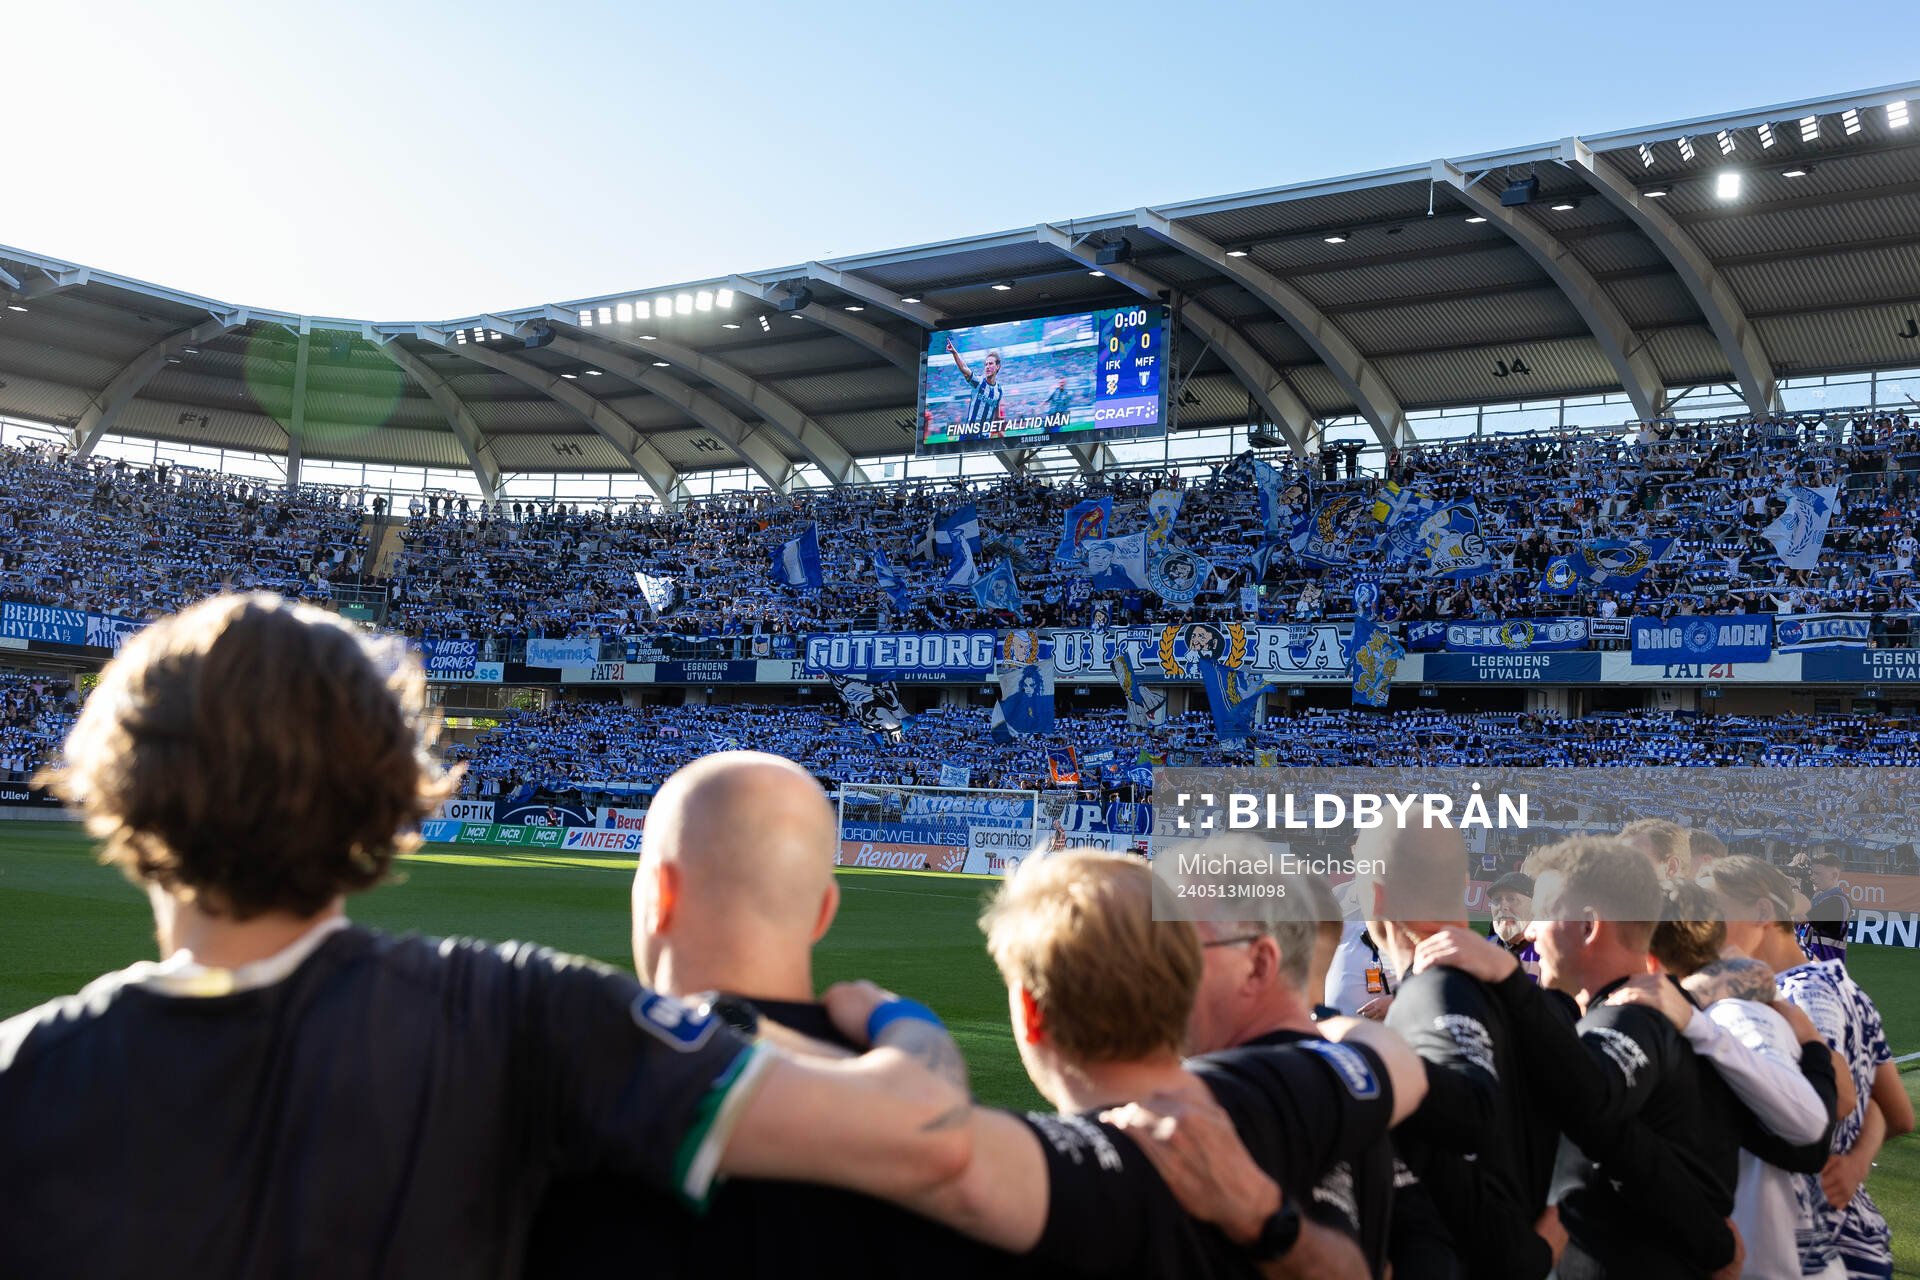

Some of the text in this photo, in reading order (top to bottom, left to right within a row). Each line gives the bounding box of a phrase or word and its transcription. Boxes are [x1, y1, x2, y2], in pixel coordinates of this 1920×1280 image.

[1115, 310, 1146, 328] 0:00
[1109, 337, 1119, 353] 0
[1141, 333, 1150, 349] 0
[1105, 360, 1121, 370] IFK
[1135, 356, 1155, 367] MFF
[1095, 405, 1145, 420] CRAFT
[946, 413, 1070, 436] FINNS DET ALLTID NÅN
[1020, 434, 1050, 443] SAMSUNG
[4, 604, 85, 627] BEBBENS
[2, 620, 60, 640] HYLLA
[1449, 626, 1501, 646] GFK
[1807, 621, 1868, 637] LIGAN
[1638, 625, 1766, 649] BRIG ADEN
[435, 641, 476, 656] HATERS
[808, 634, 993, 668] GÖTEBORG
[431, 656, 475, 669] CORNER
[682, 662, 729, 671] LEGENDENS
[1471, 655, 1551, 667] LEGENDENS
[591, 663, 624, 681] FAT21
[687, 671, 723, 681] UTVALDA
[1479, 668, 1541, 680] UTVALDA
[0, 790, 30, 800] Ullevi
[451, 804, 493, 820] OPTIK
[466, 827, 486, 837] MCR
[501, 828, 520, 839] MCR
[536, 830, 557, 841] MCR
[975, 830, 1032, 848] granitor
[855, 844, 927, 870] Renova
